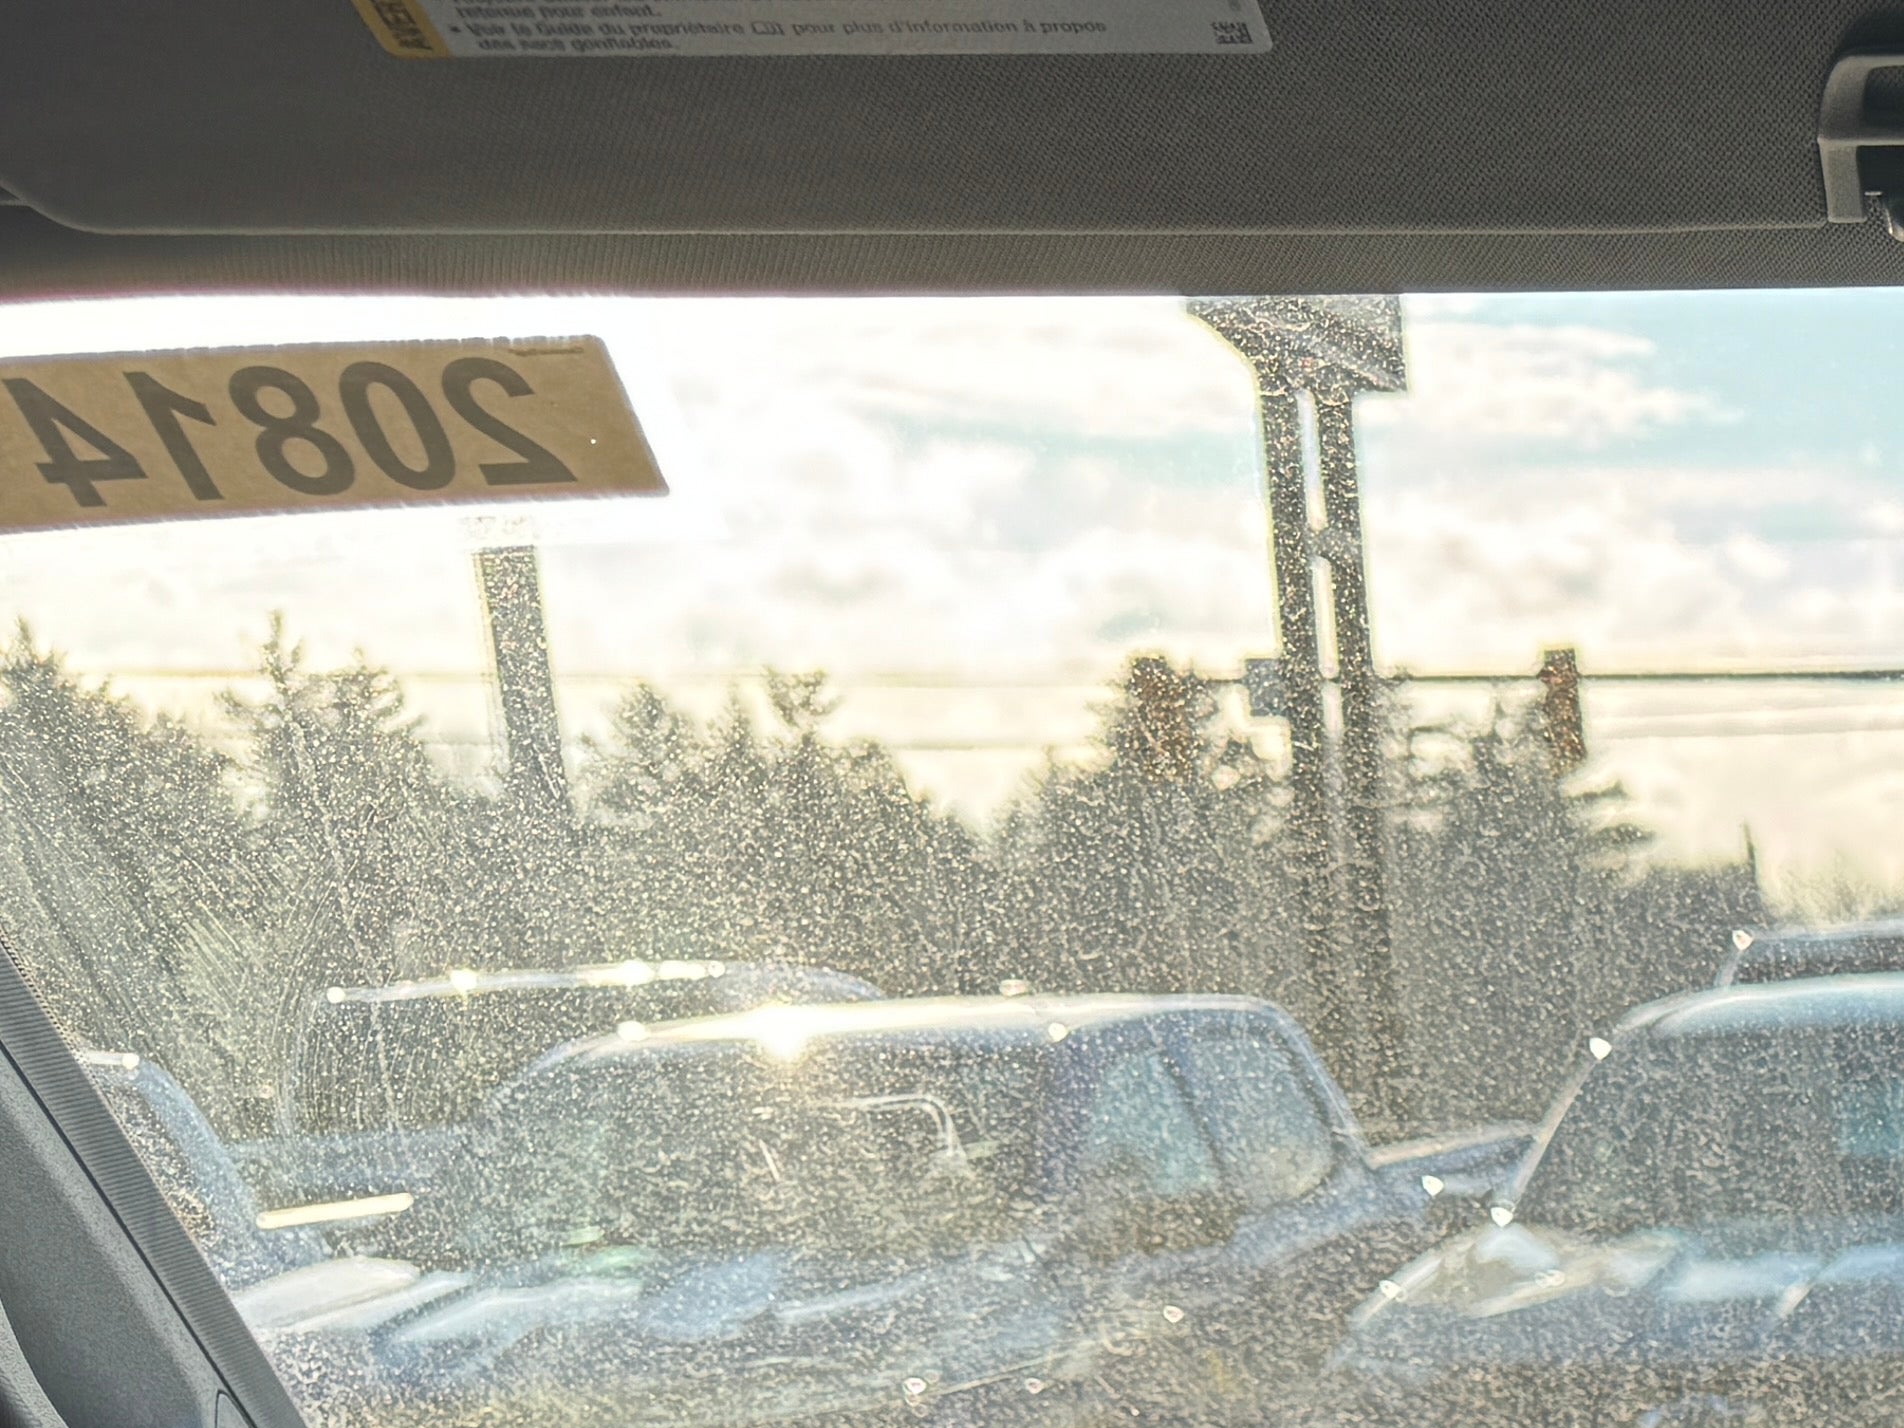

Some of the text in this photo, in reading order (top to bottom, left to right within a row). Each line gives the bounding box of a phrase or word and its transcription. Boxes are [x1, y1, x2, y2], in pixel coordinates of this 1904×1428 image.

[792, 24, 834, 37] pour
[843, 22, 882, 36] plus
[1040, 22, 1107, 36] propos
